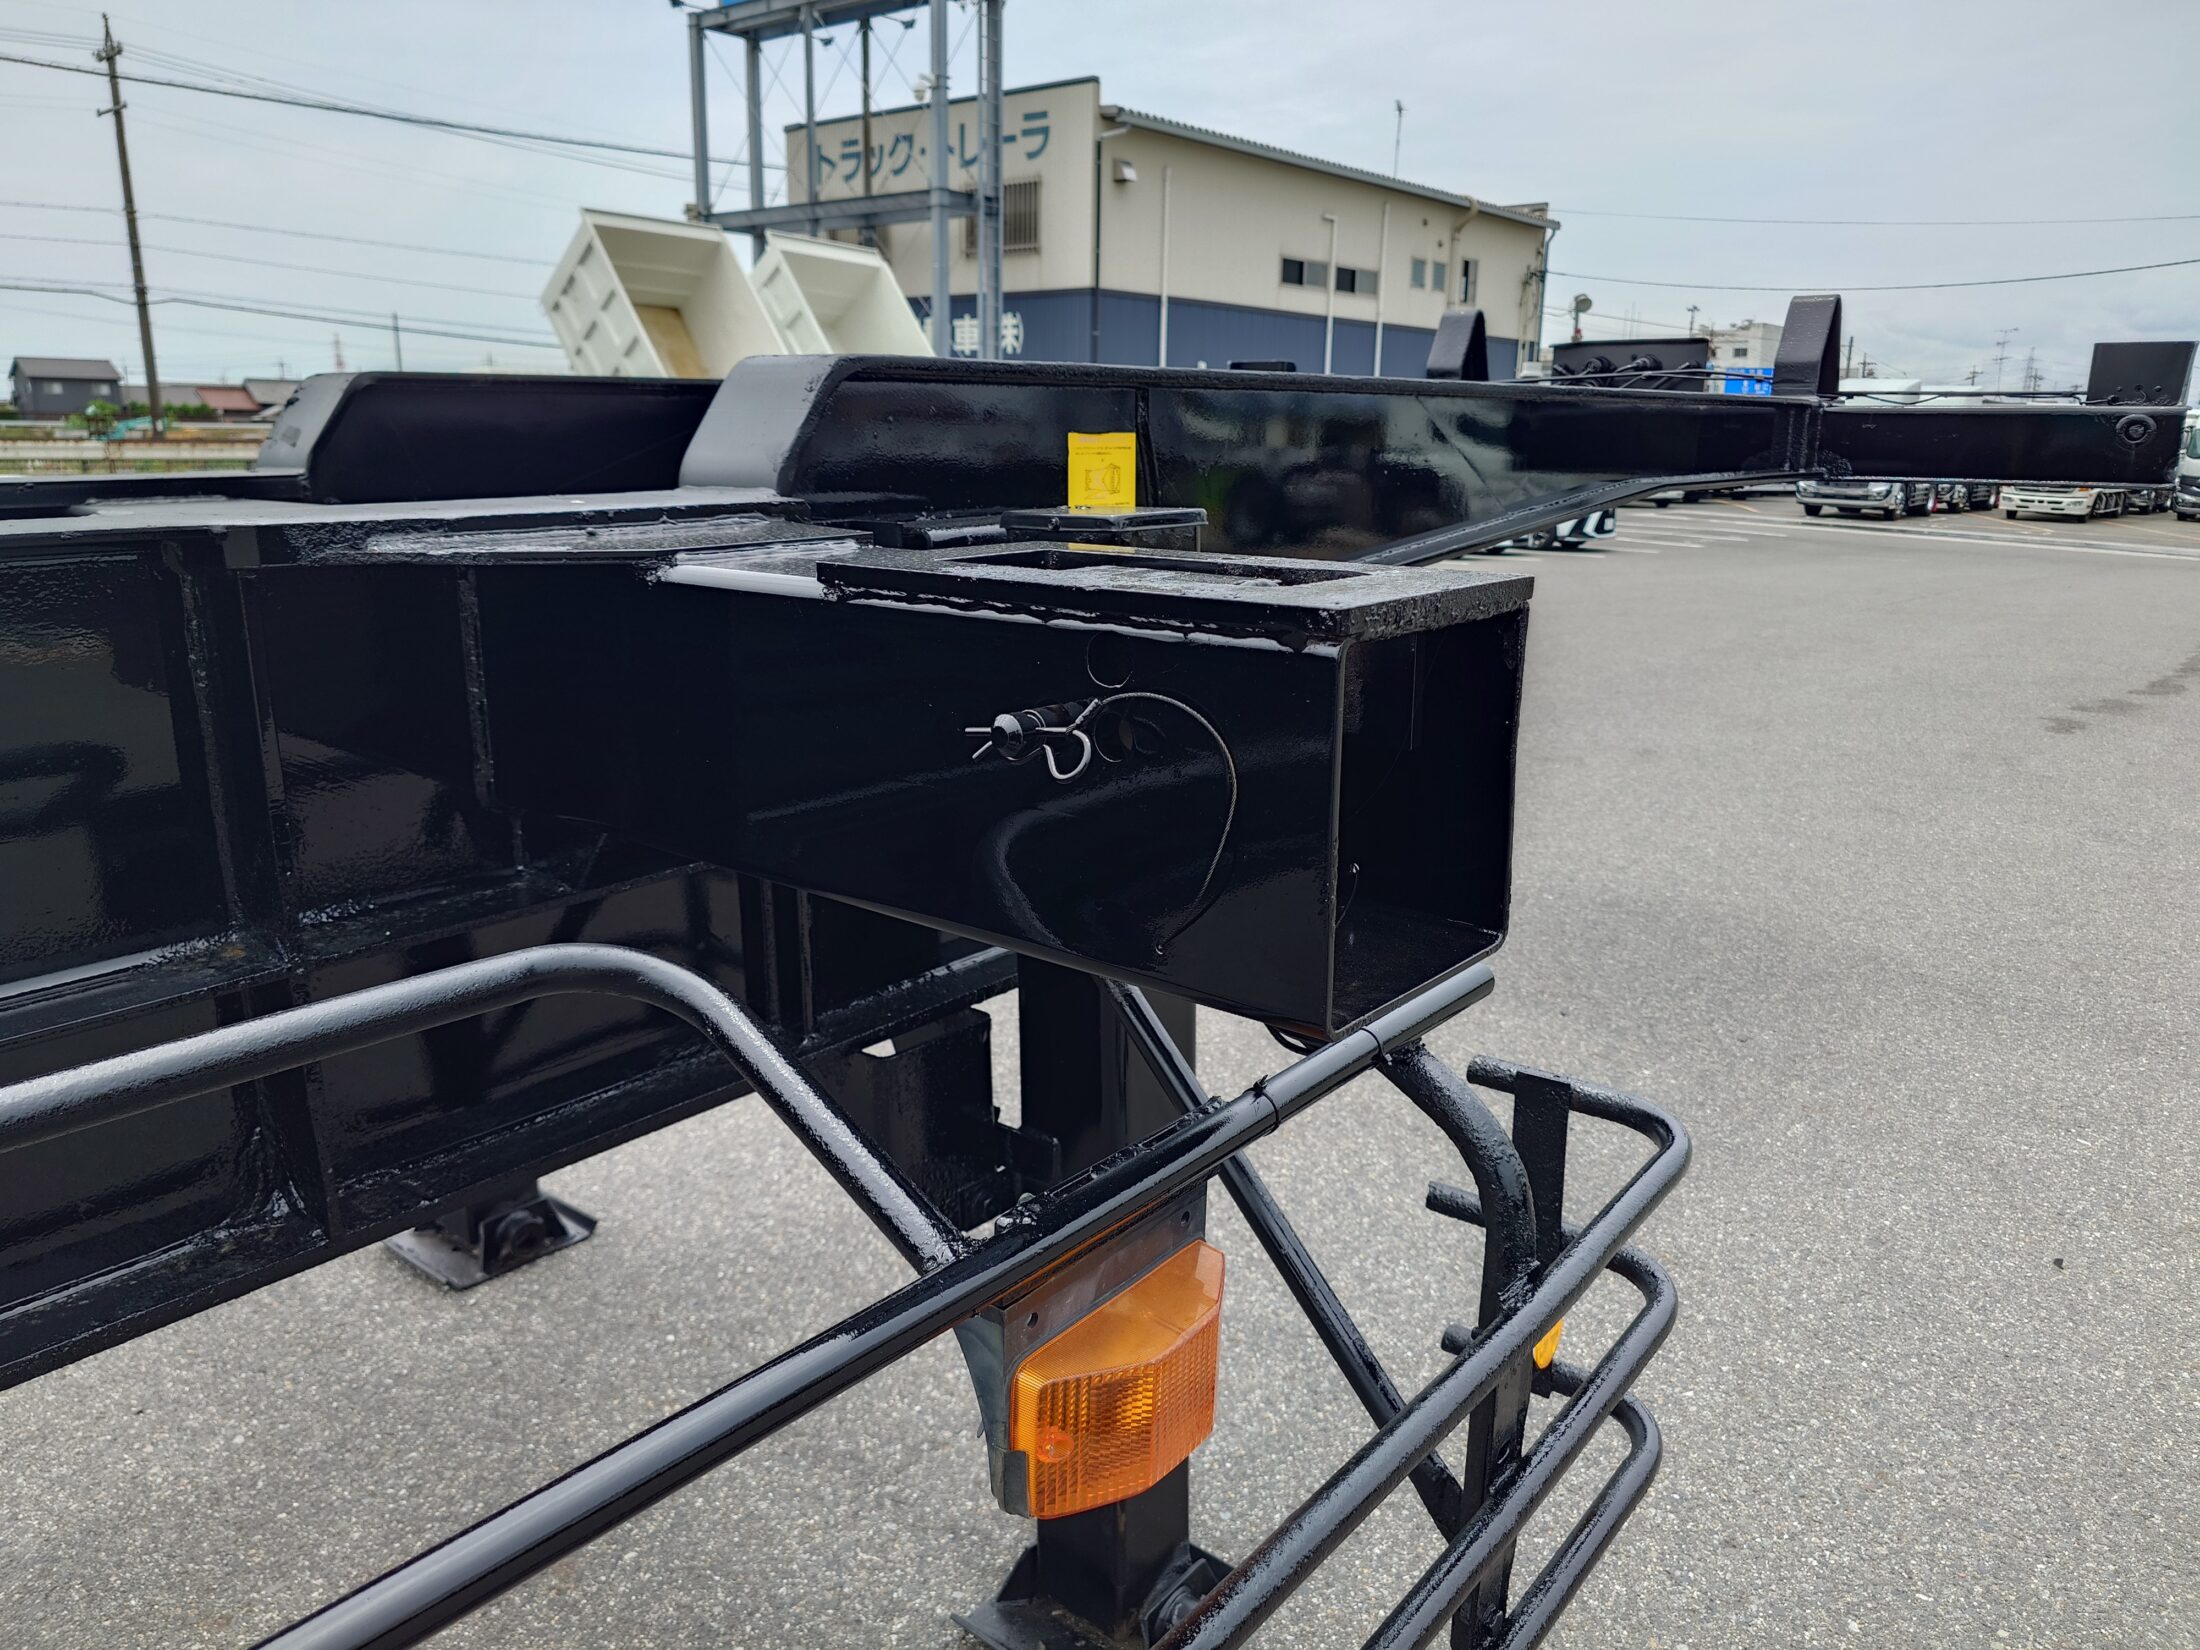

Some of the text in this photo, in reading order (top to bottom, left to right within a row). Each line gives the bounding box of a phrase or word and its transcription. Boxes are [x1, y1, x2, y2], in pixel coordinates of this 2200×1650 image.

[816, 110, 1050, 185] トラック・レーラ
